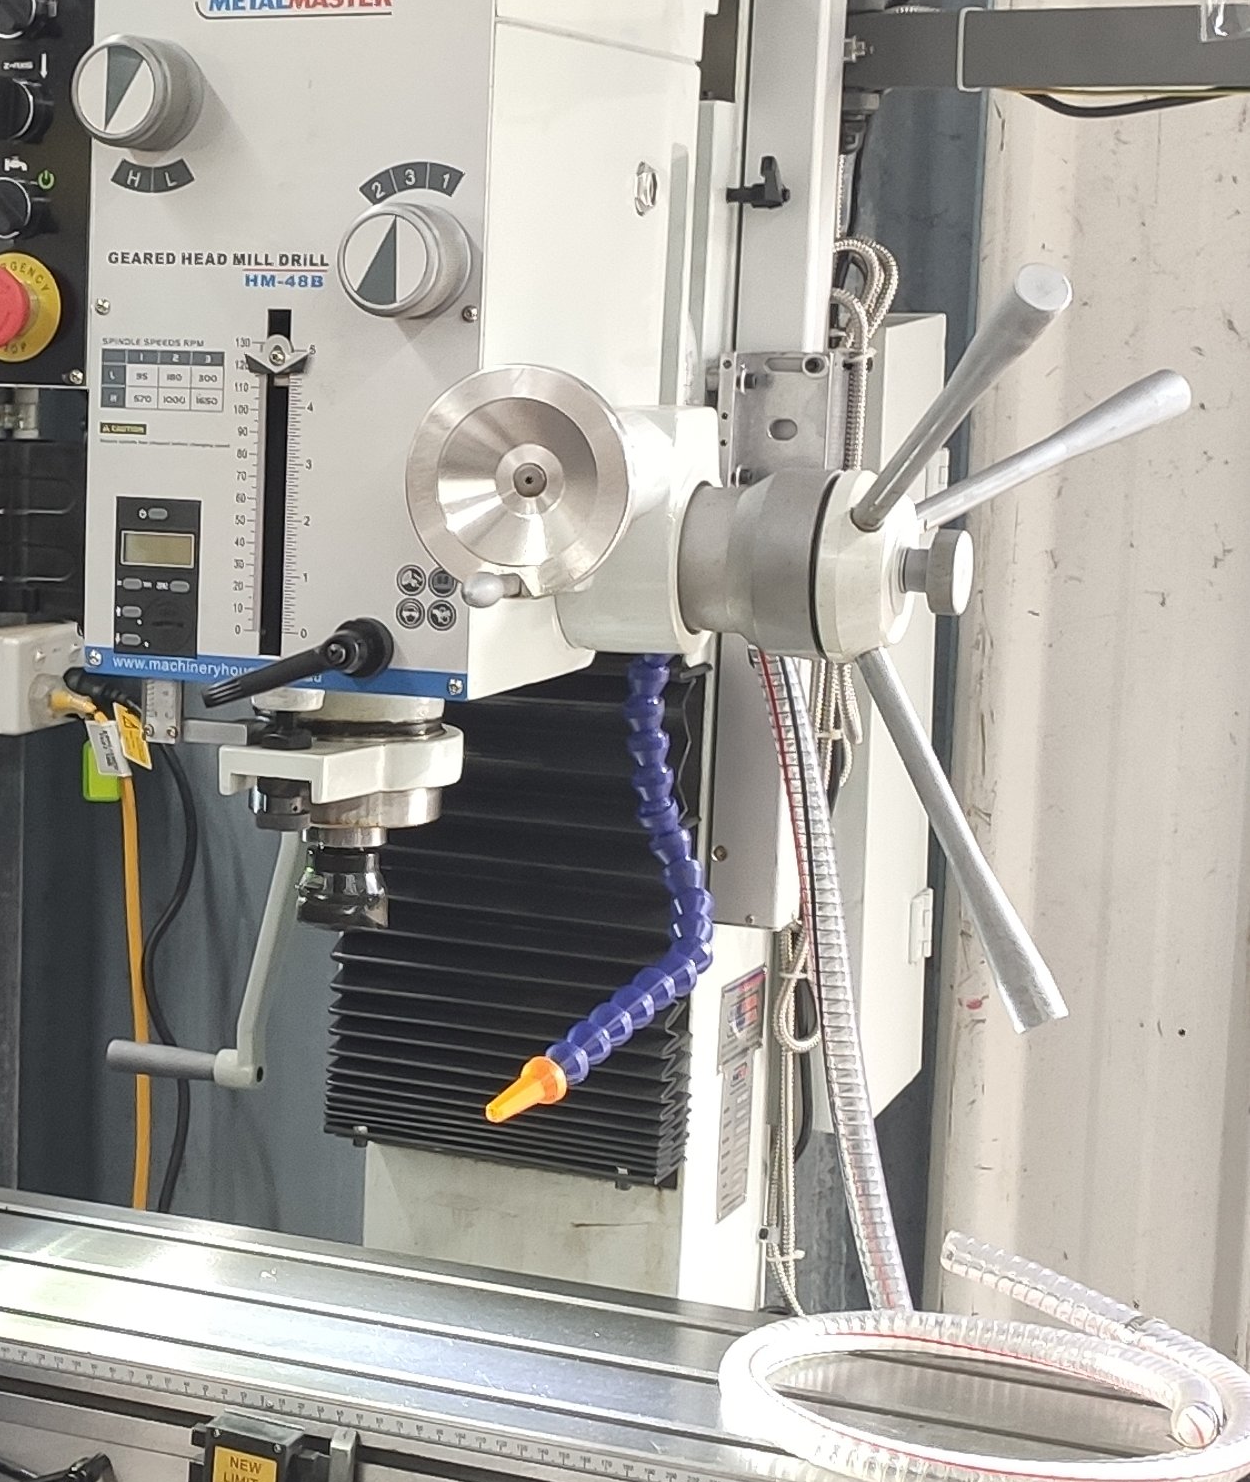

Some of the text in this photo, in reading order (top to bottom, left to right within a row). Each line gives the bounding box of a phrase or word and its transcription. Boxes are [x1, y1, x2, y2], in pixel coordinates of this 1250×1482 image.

[126, 170, 178, 187] H L
[370, 169, 450, 200] 2 3 1
[108, 251, 330, 268] GEARED HEAD MILL DRILL
[4, 261, 50, 293] GENCY
[244, 273, 324, 289] HM-48B
[102, 337, 205, 347] SPINDLE SPEEDS RPM
[235, 337, 250, 348] 130
[234, 382, 249, 393] 110
[233, 404, 249, 415] 100
[306, 401, 314, 412] 4
[237, 426, 248, 437] 90
[305, 459, 313, 470] 3
[236, 471, 247, 481] 70
[303, 516, 311, 527] 2
[234, 536, 245, 547] 40
[232, 602, 243, 613] 10
[234, 624, 241, 635] 0
[300, 628, 308, 639] 0
[229, 1456, 262, 1474] NEW
